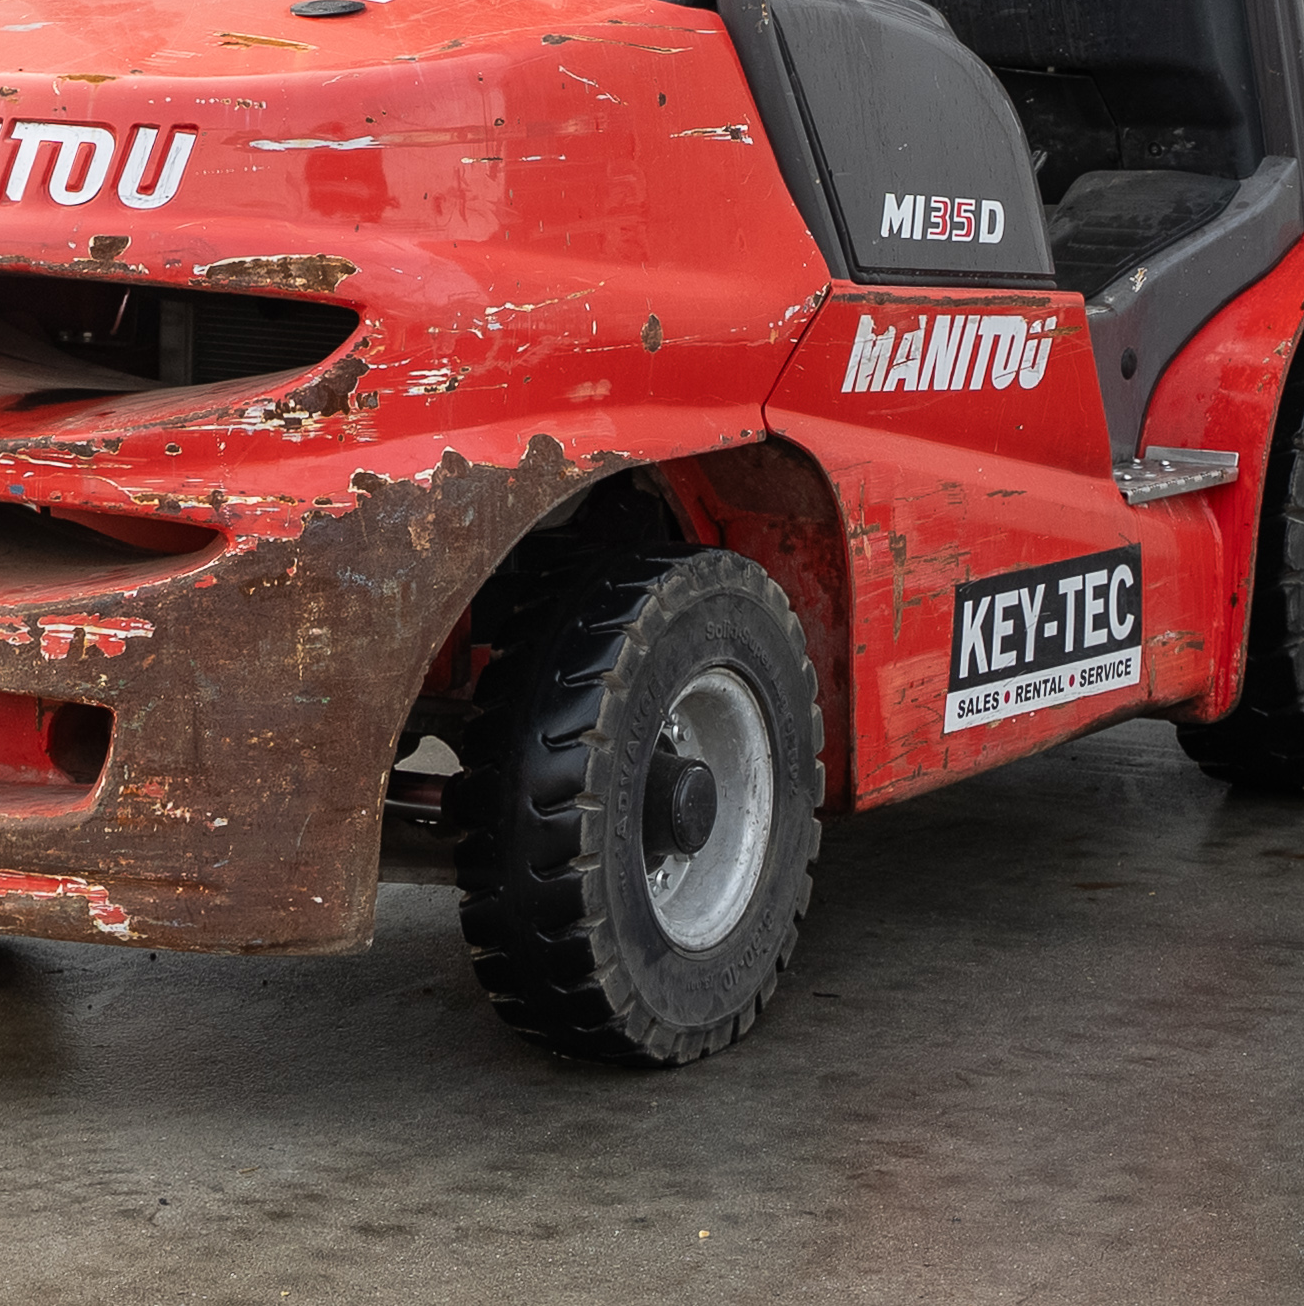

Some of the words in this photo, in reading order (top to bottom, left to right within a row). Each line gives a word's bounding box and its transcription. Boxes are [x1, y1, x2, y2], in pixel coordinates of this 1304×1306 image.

[841, 314, 1057, 393] MANITOU
[959, 563, 1135, 679] KEY-TEC
[957, 690, 1000, 719] SALES
[1014, 674, 1065, 705] RENTAL
[1078, 657, 1132, 688] SERVICE
